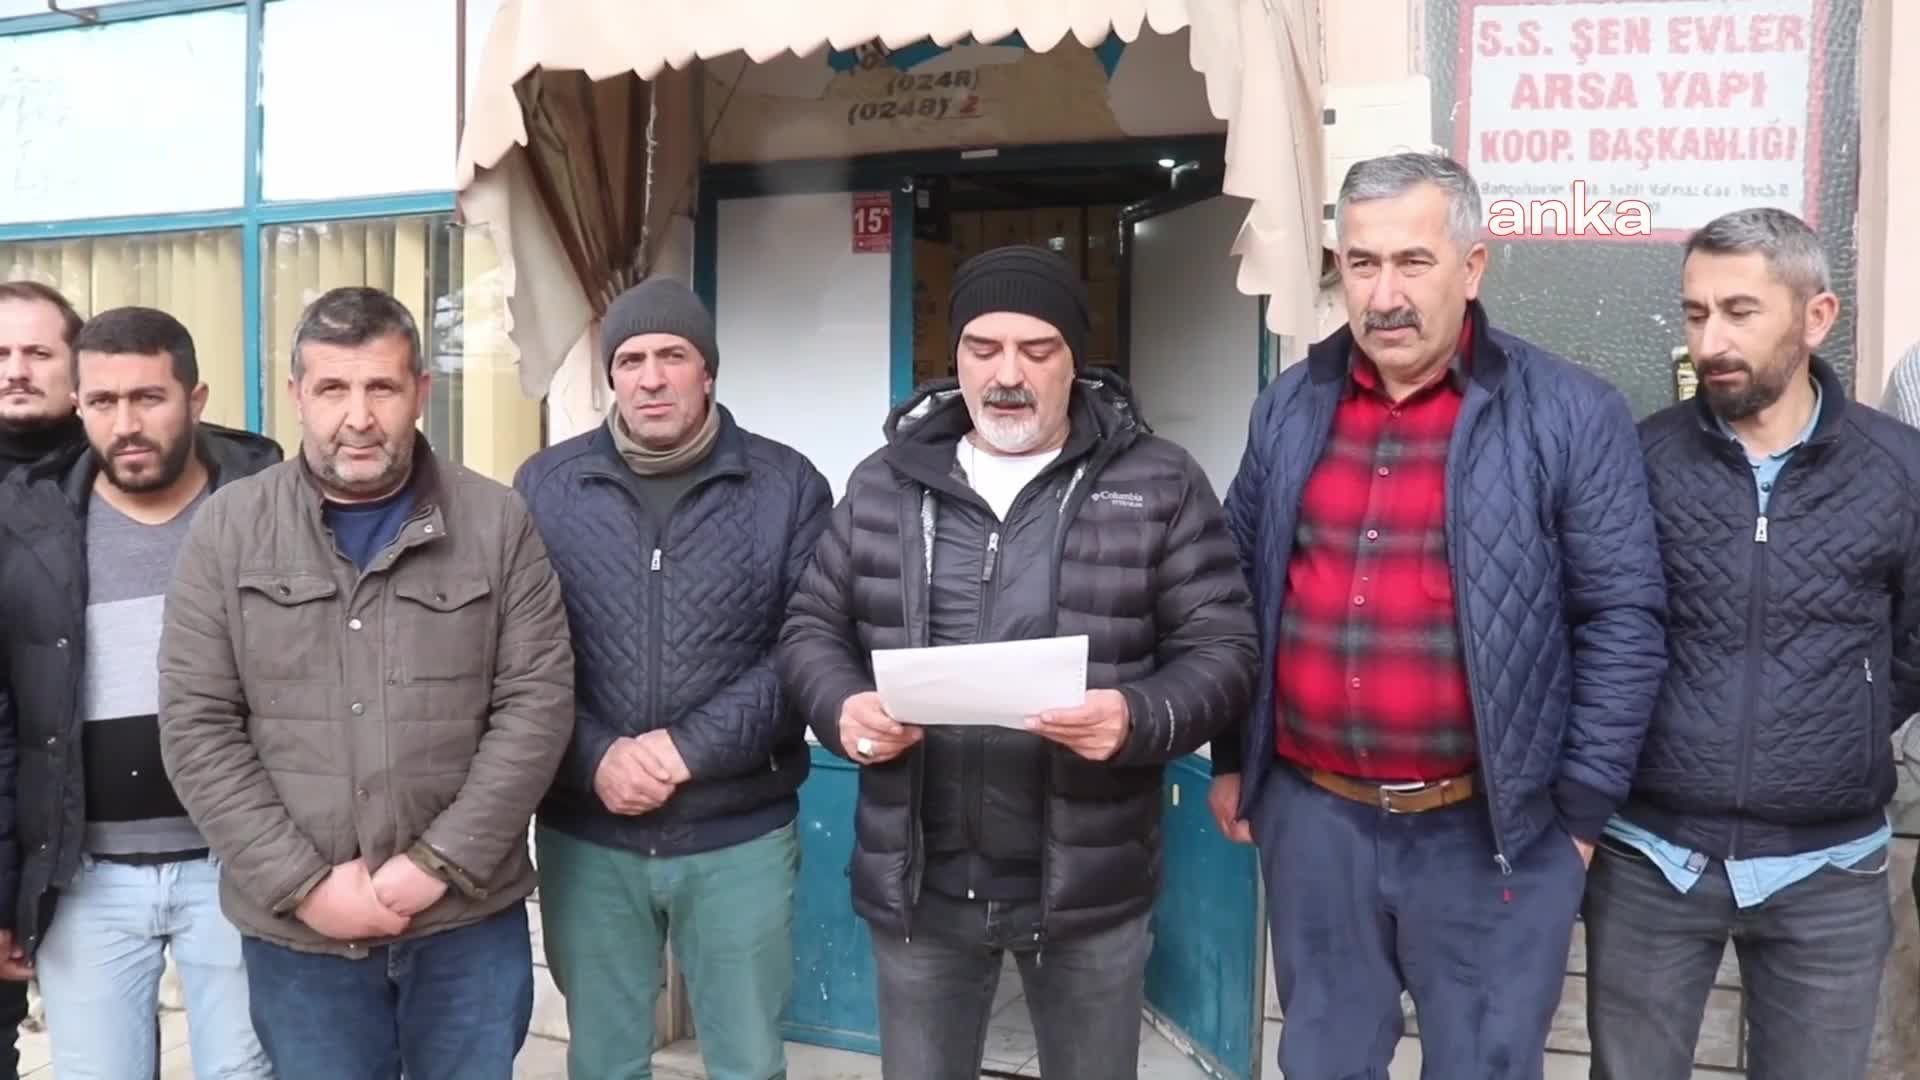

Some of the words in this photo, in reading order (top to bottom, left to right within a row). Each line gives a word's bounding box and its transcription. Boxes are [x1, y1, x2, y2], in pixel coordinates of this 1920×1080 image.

[1478, 19, 1553, 56] S.S.
[1570, 16, 1651, 65] ŞEN
[1667, 14, 1807, 54] EVLER
[1510, 72, 1638, 110] ARSA
[1657, 70, 1768, 108] YAPI
[1480, 128, 1575, 163] KOOP.
[1588, 118, 1797, 170] BAŞKANLIĞI
